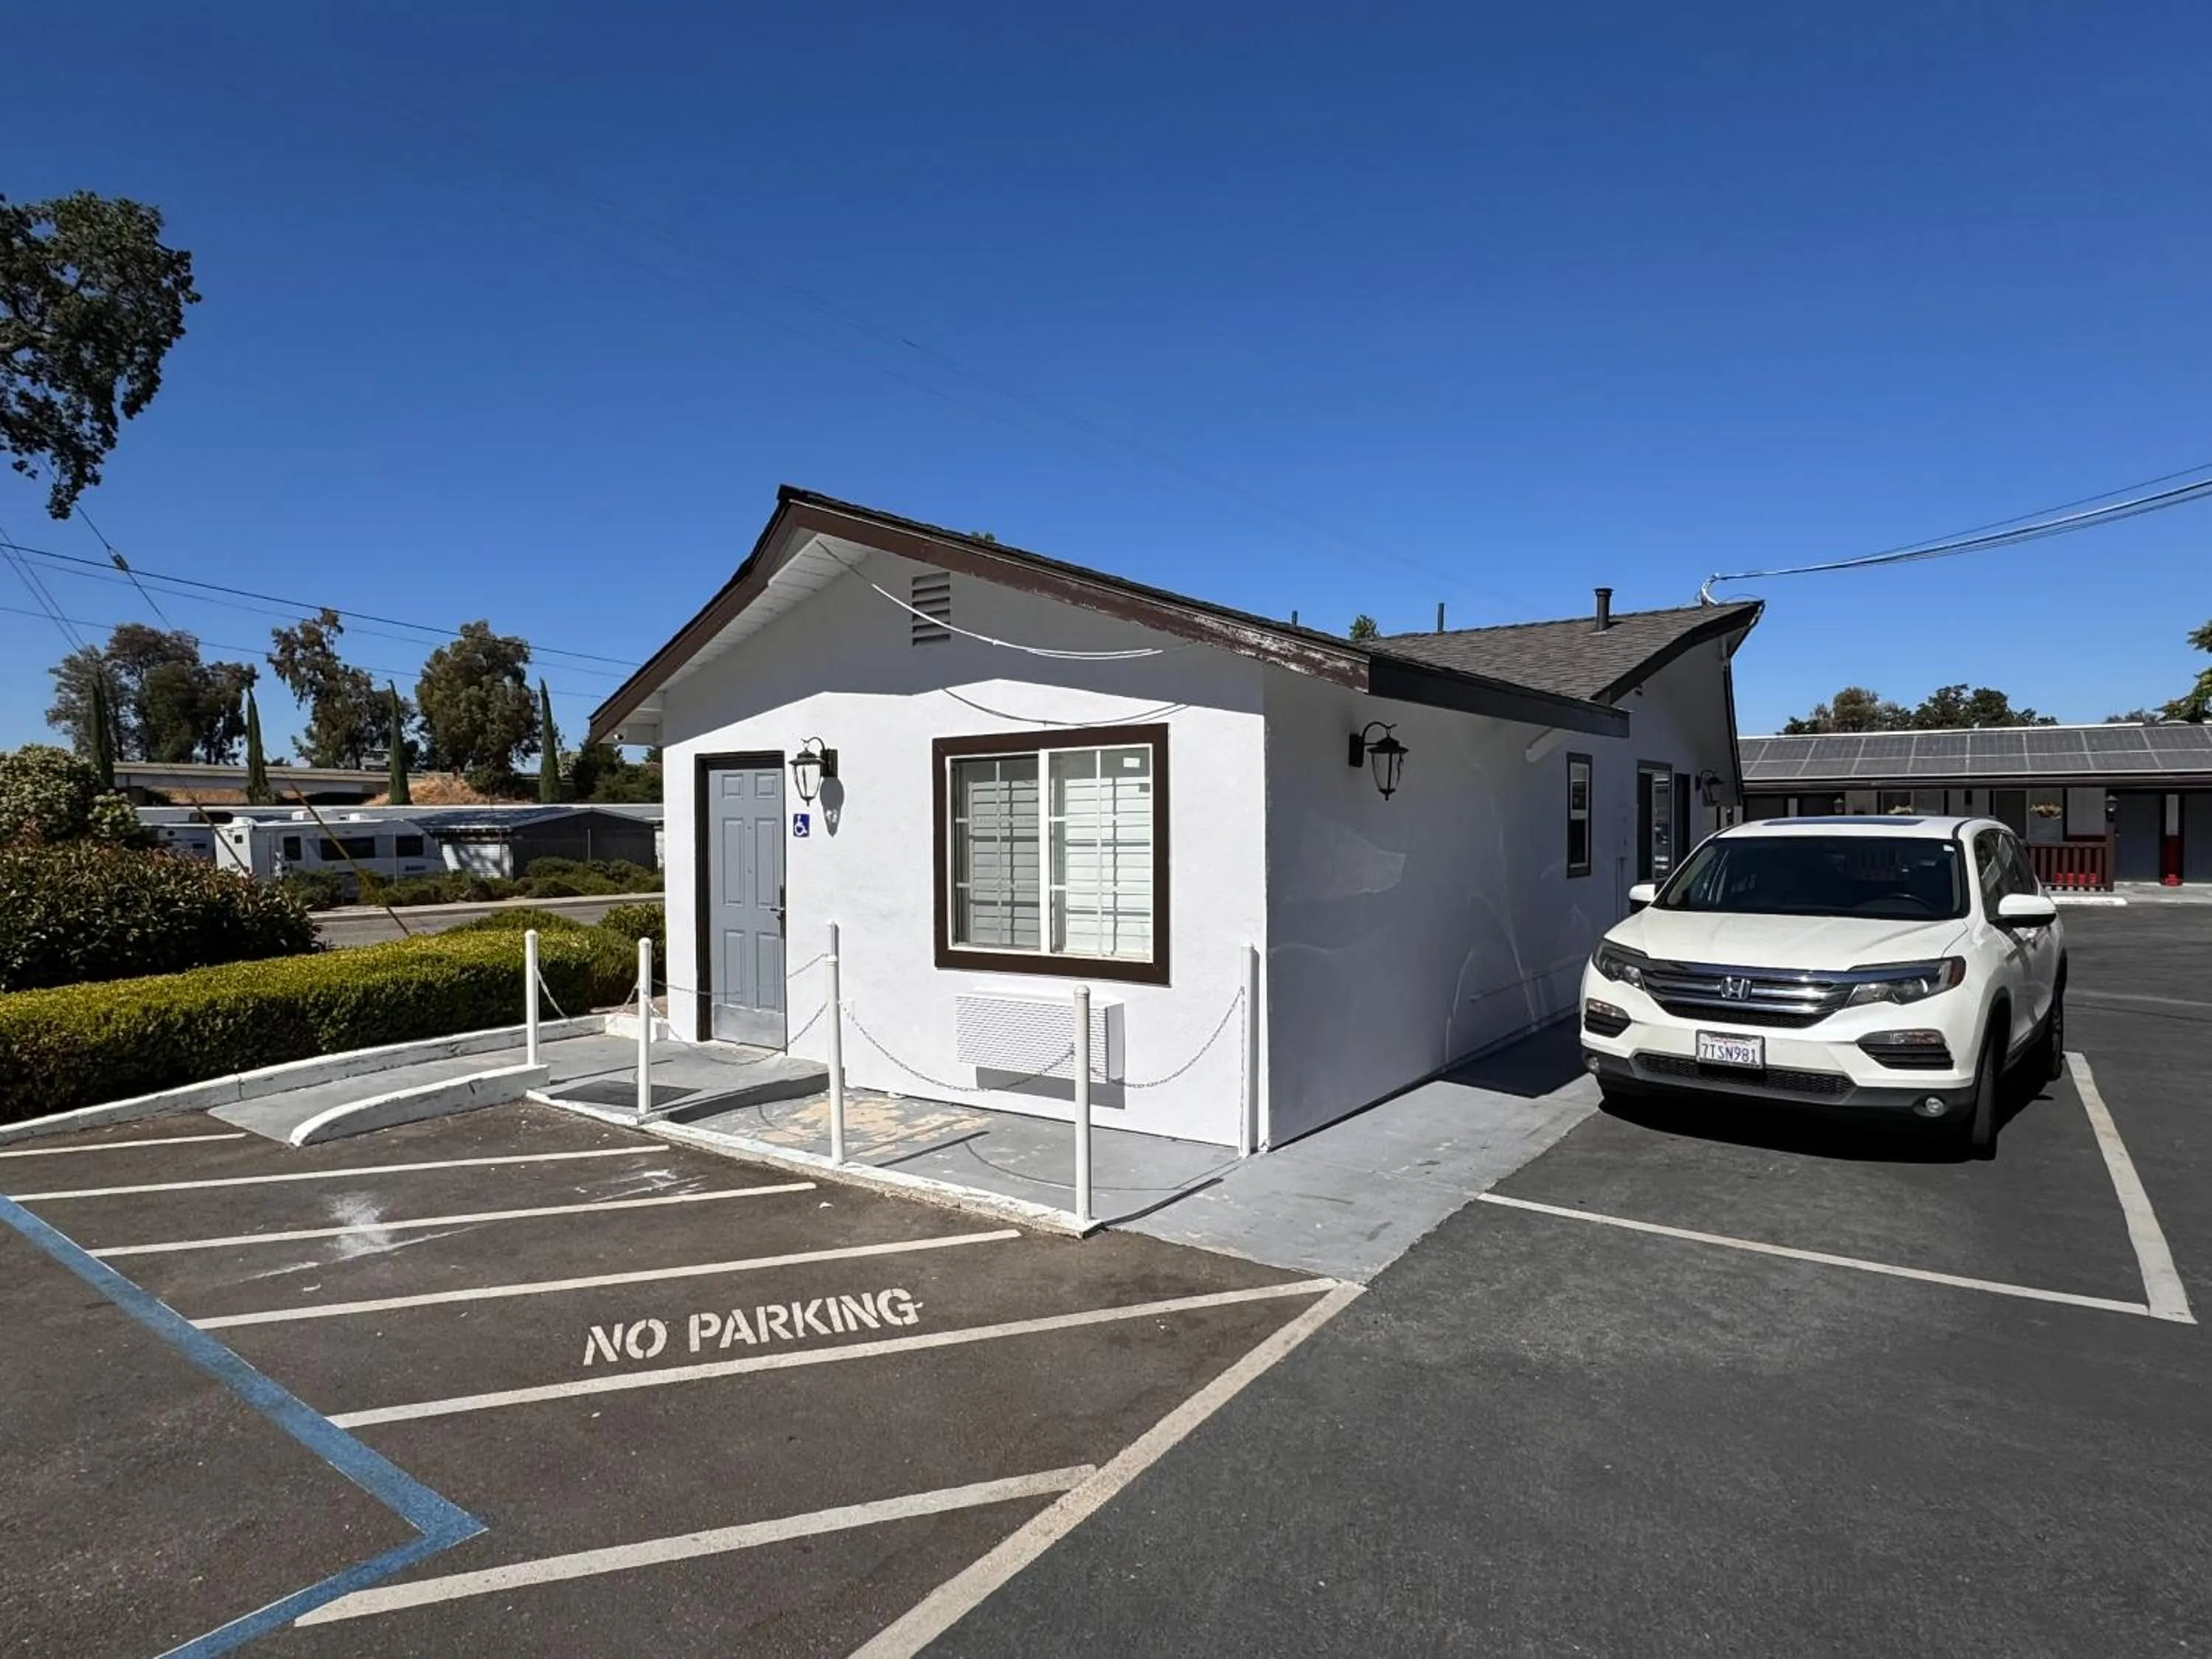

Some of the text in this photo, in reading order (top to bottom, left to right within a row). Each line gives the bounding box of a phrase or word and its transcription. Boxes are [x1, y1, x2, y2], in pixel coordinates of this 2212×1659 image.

[1702, 1043, 1758, 1063] 7TSN981
[583, 1287, 922, 1366] NO PARKING
